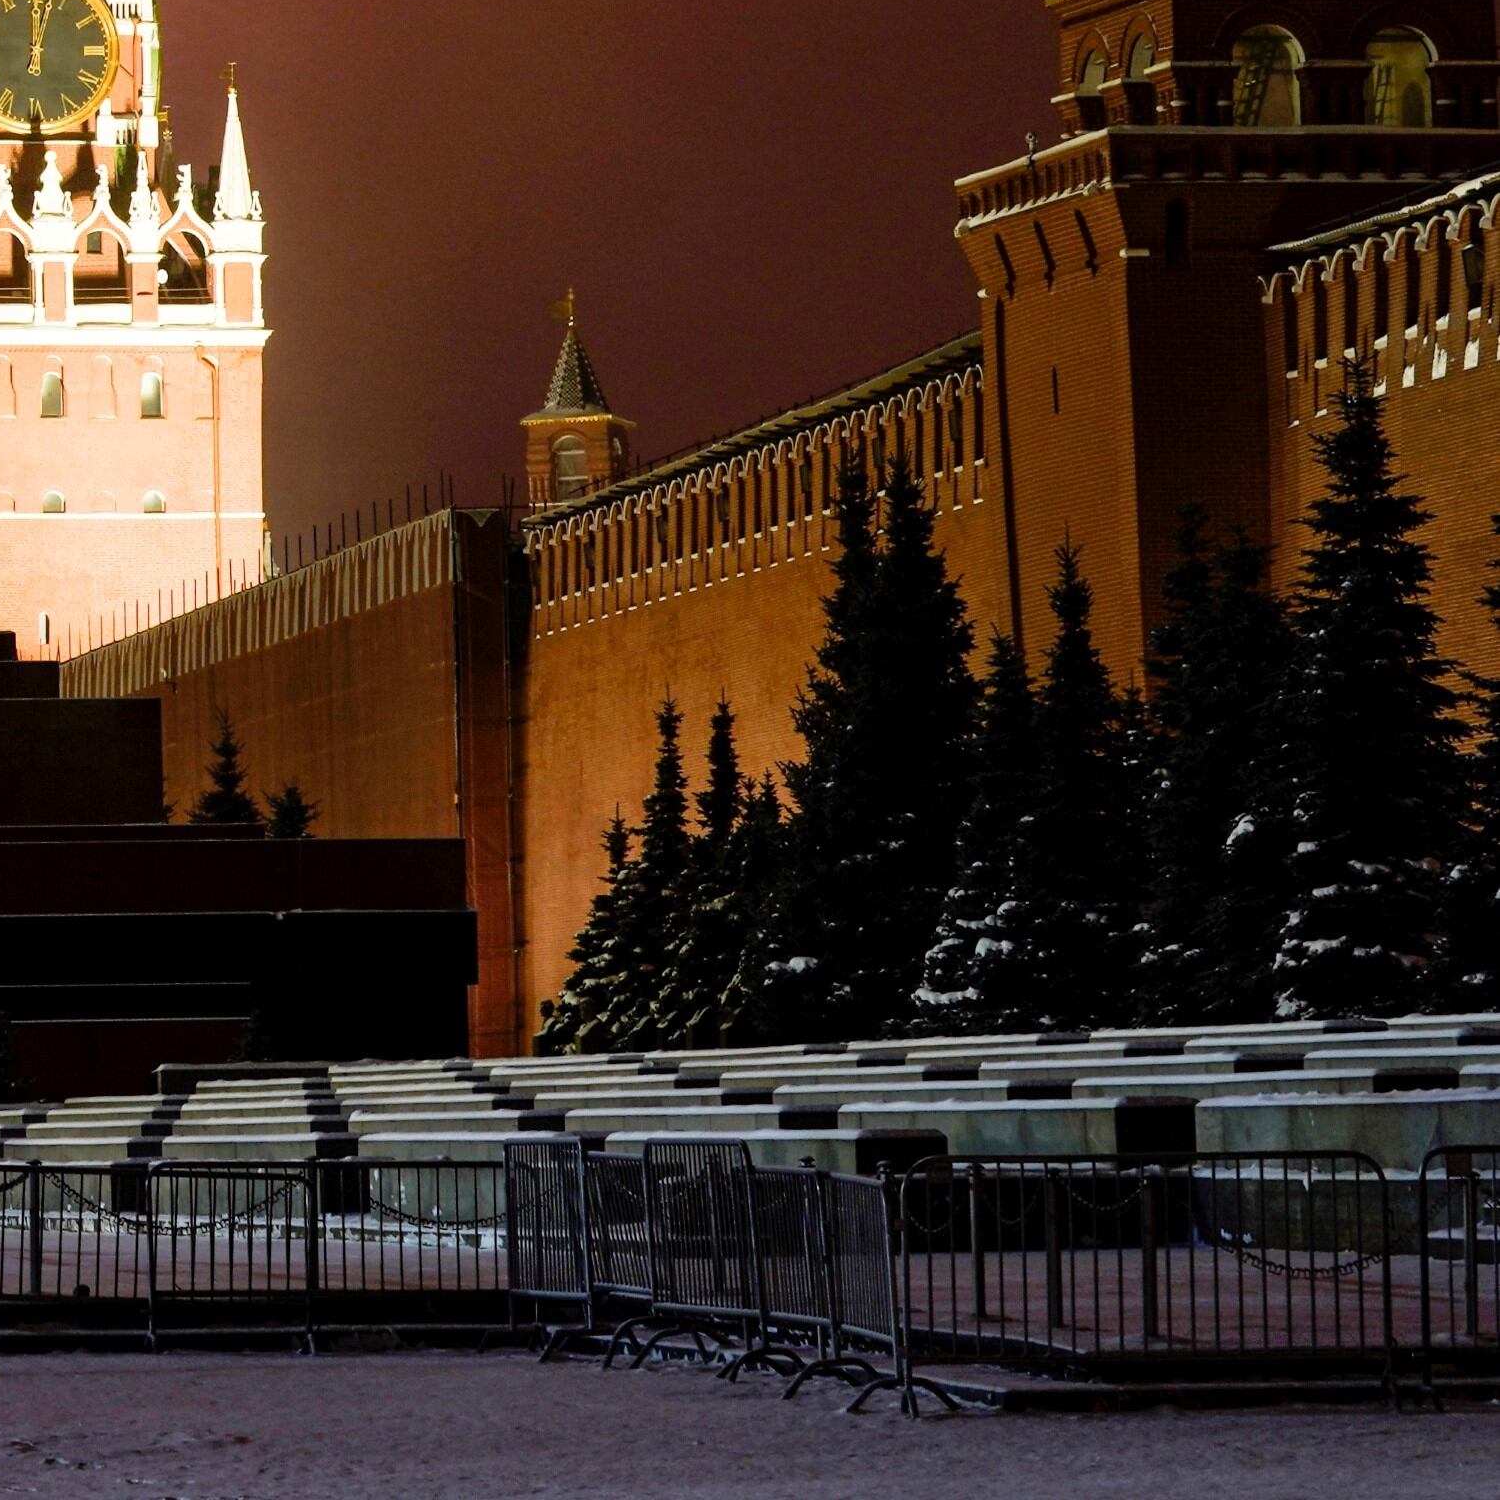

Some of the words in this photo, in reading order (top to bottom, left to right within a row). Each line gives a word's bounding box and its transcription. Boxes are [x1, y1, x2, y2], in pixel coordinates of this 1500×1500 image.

[75, 14, 97, 30] II
[83, 45, 106, 57] III
[77, 68, 100, 93] IV
[60, 93, 79, 115] V
